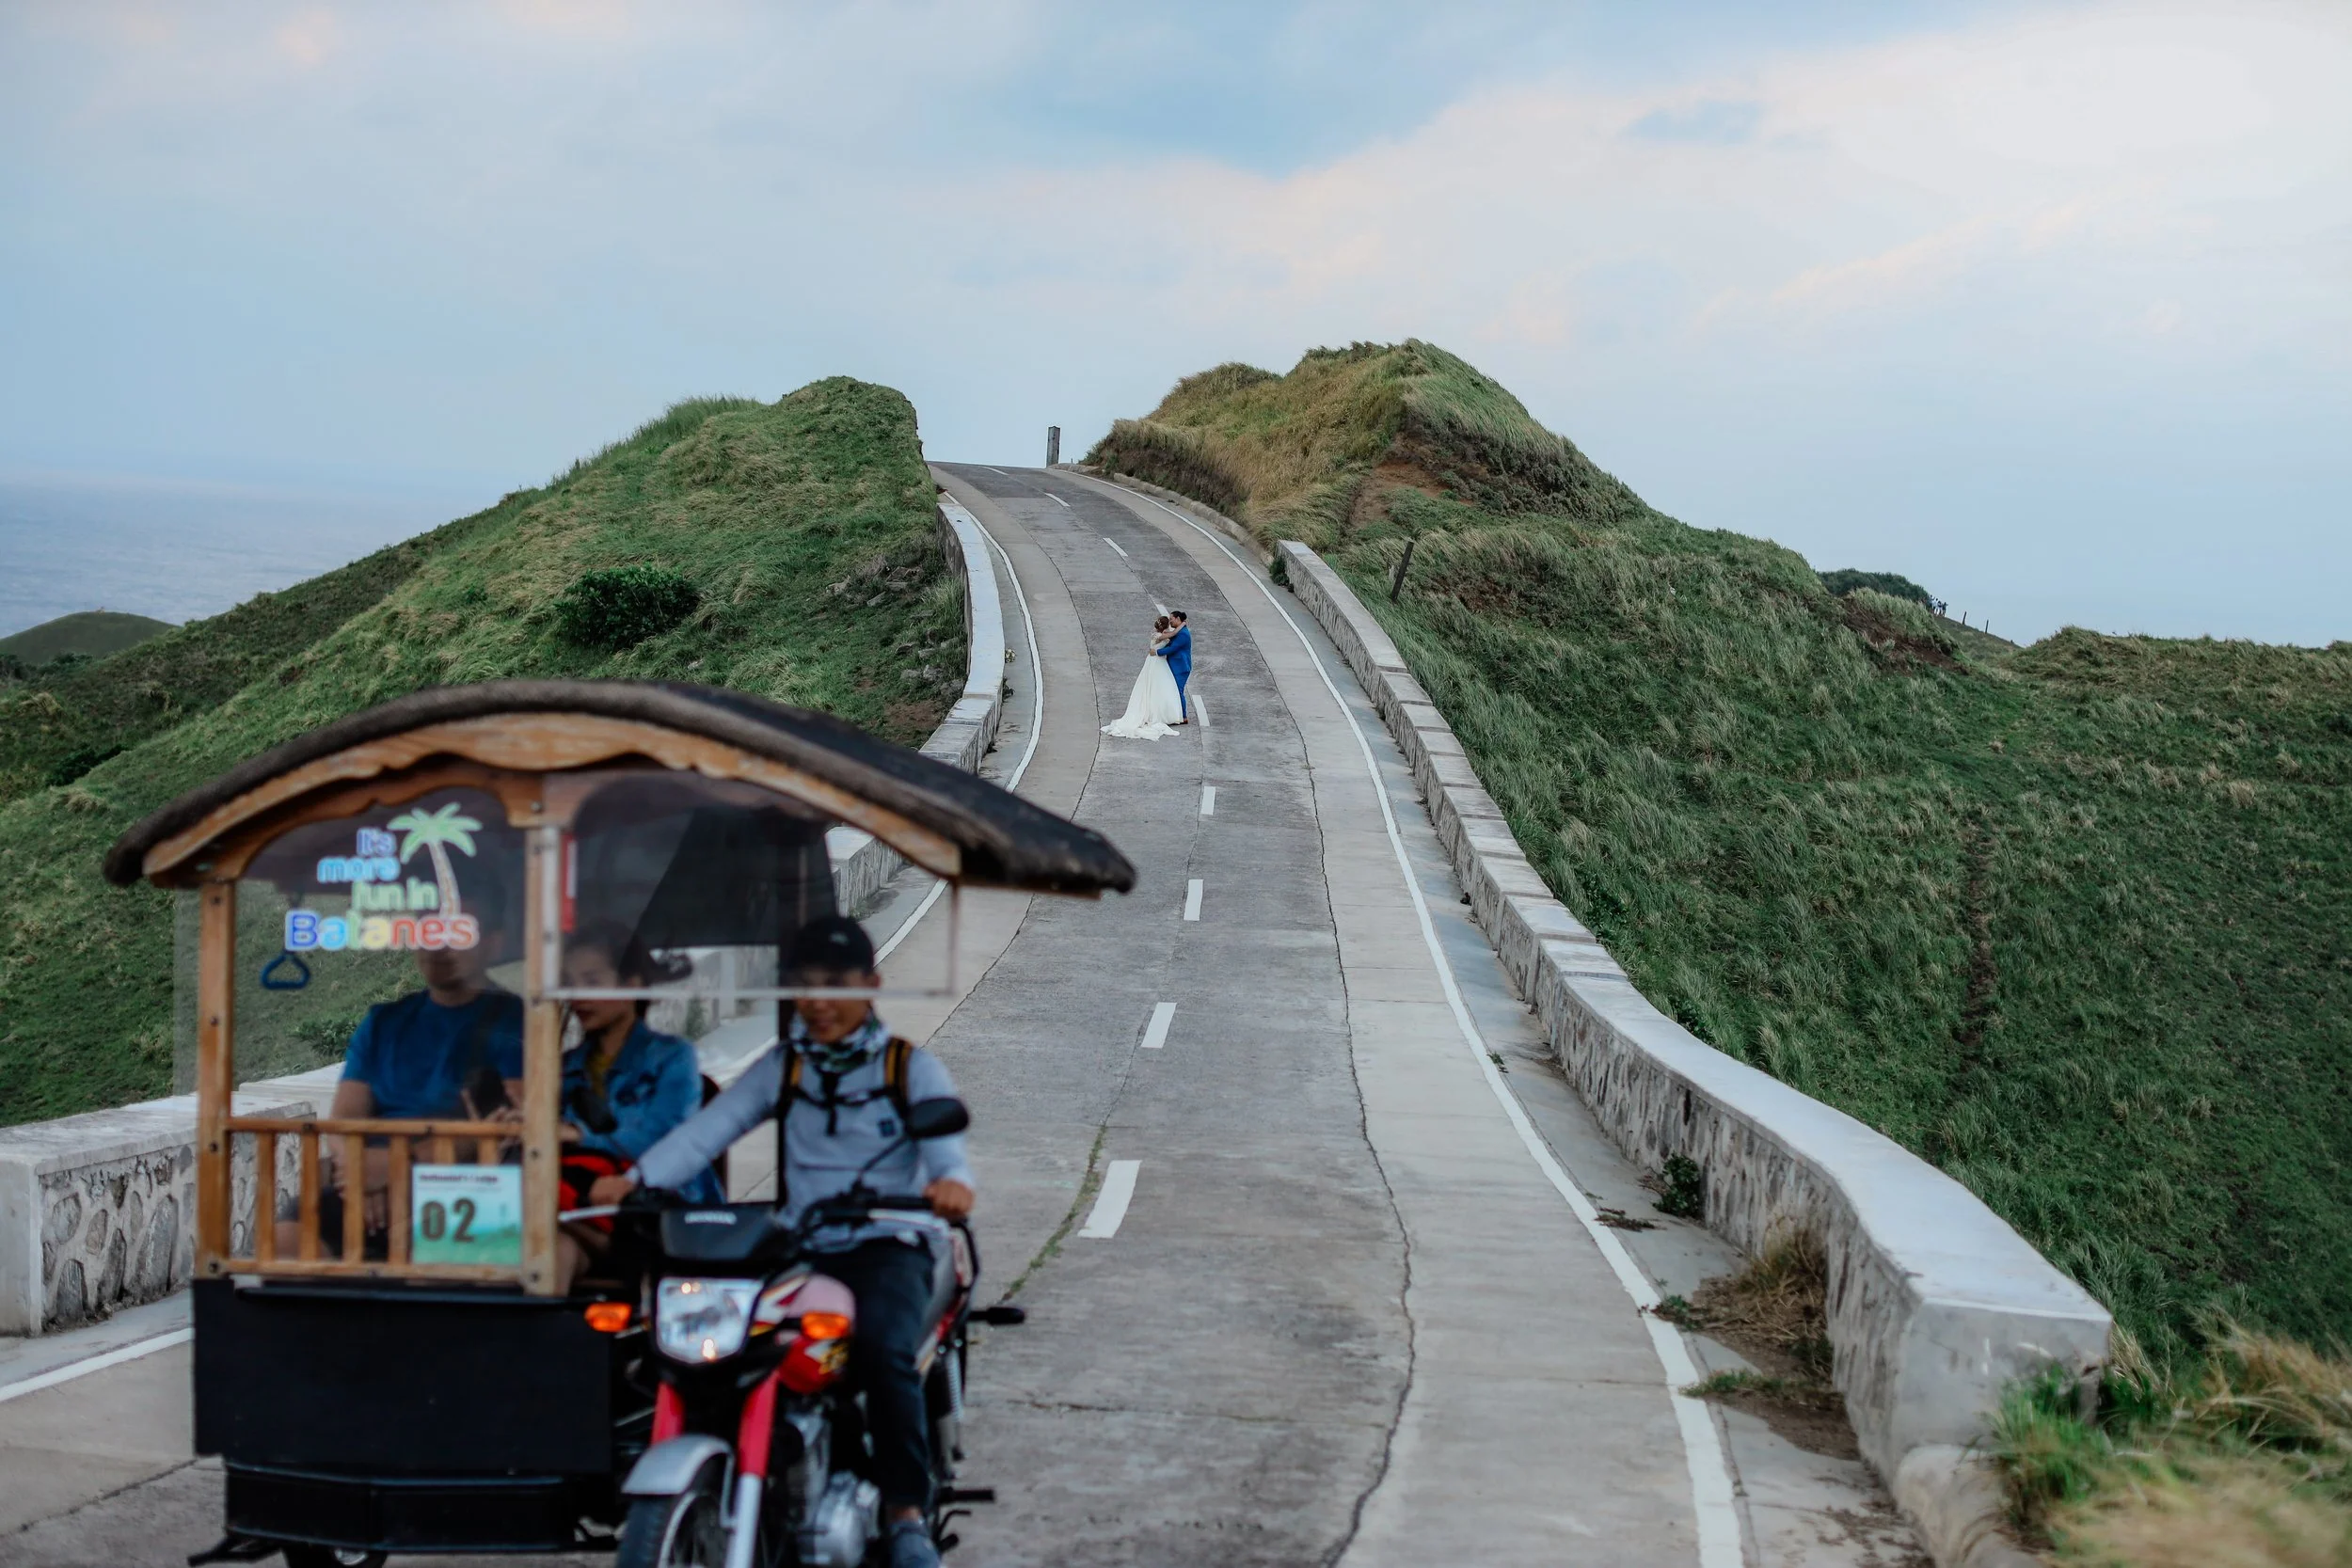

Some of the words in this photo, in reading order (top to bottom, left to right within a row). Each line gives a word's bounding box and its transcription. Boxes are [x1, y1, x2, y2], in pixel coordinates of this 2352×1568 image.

[317, 857, 401, 883] more
[351, 882, 405, 911] fun
[406, 877, 438, 910] in
[421, 1197, 476, 1243] 02
